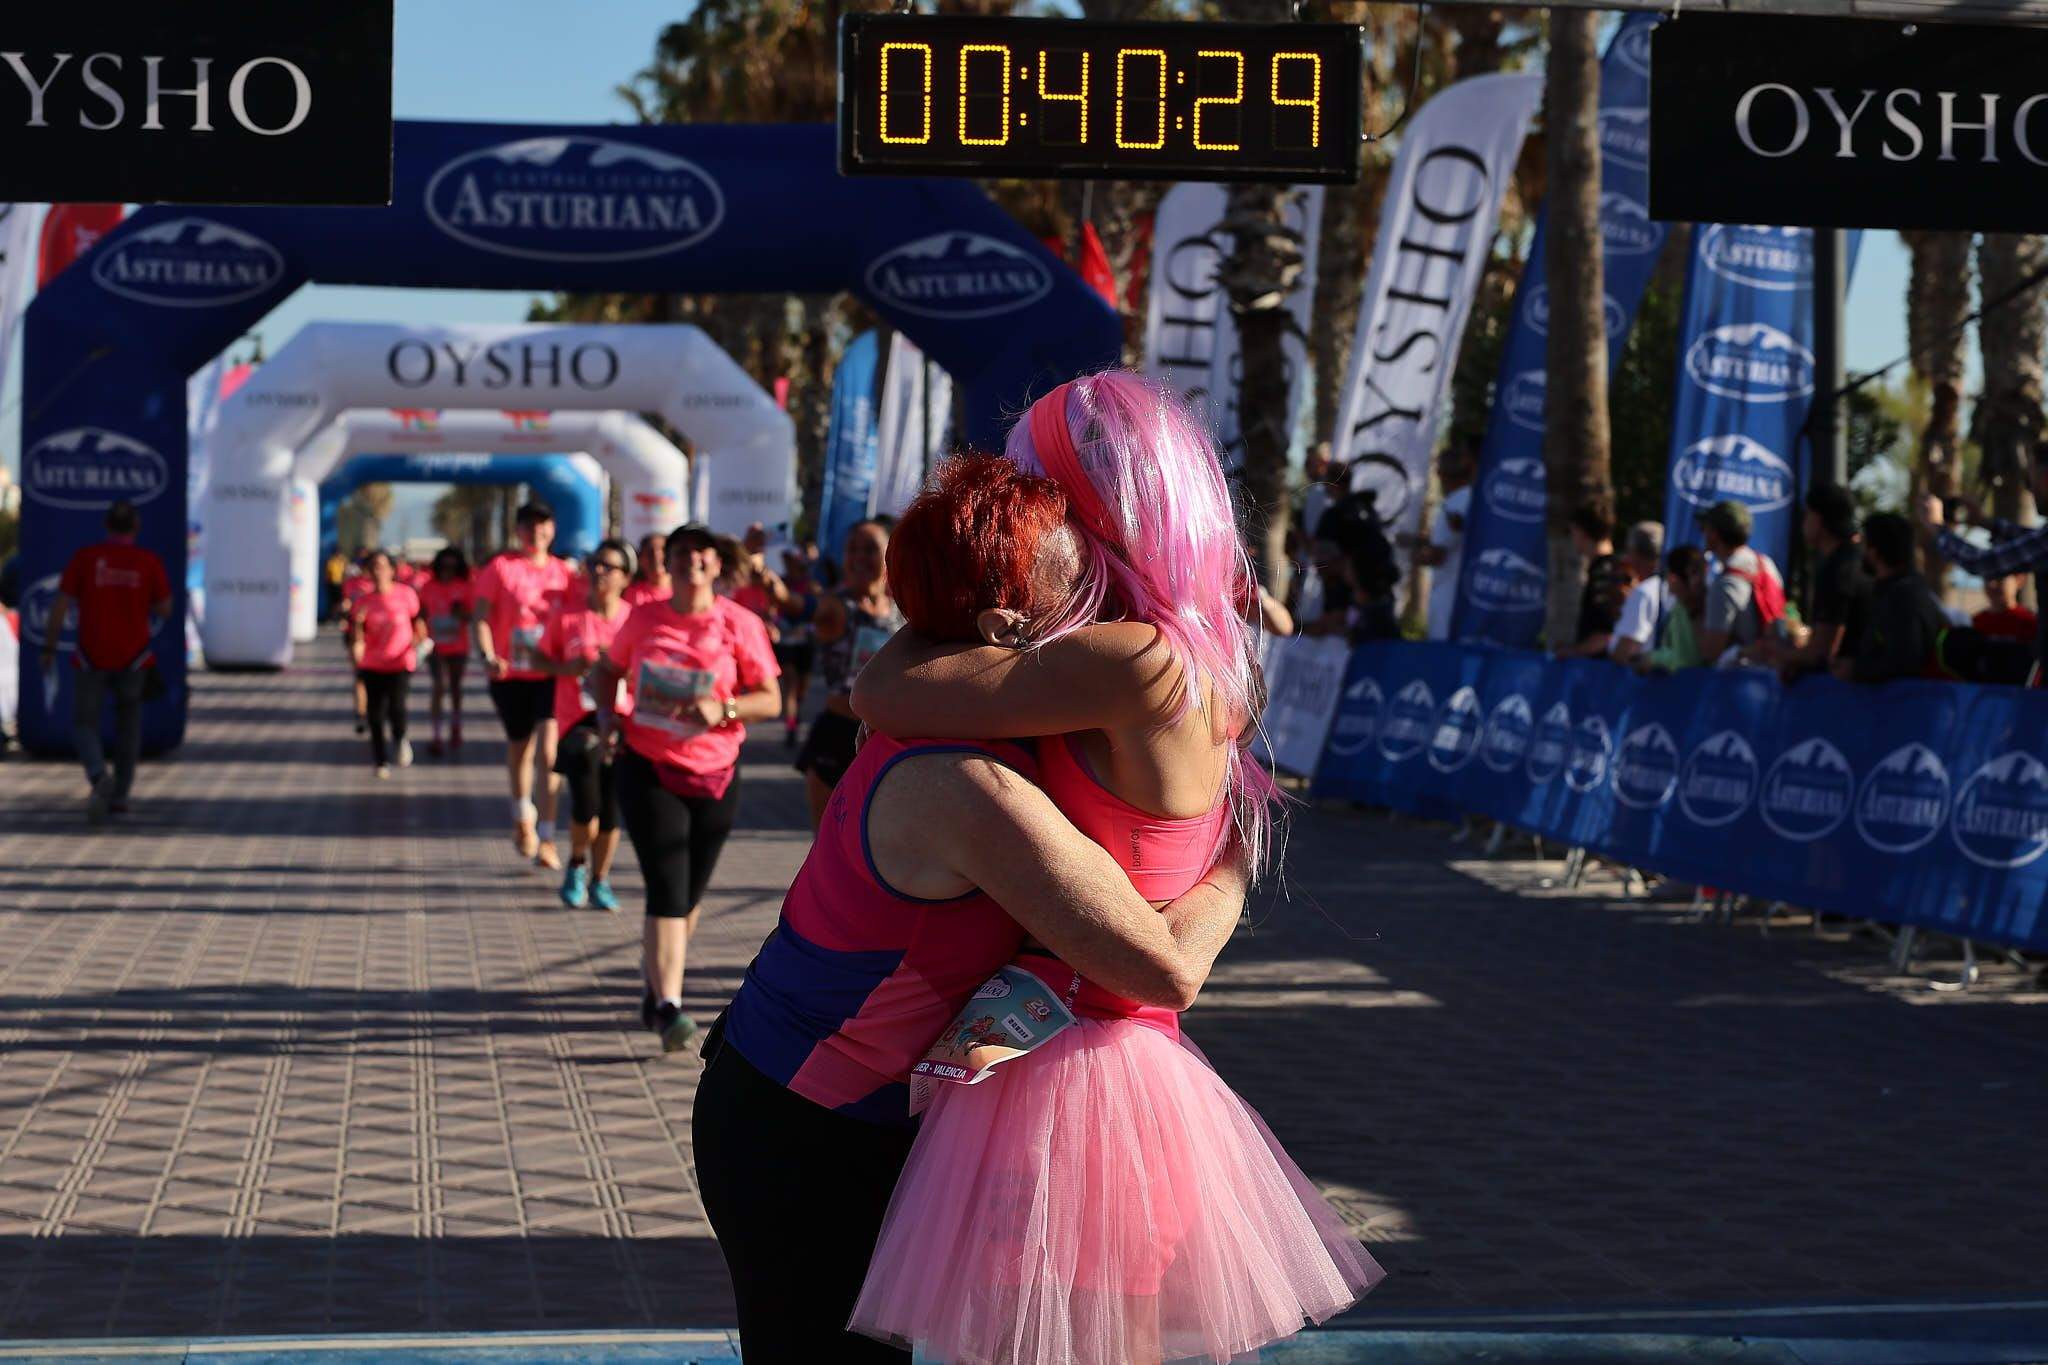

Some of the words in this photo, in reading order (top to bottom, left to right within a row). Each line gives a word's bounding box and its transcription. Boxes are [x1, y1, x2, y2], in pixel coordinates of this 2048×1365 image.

[450, 172, 700, 230] ASTURIANA
[386, 338, 620, 390] OYSHO
[933, 1064, 968, 1080] VALENCIA
